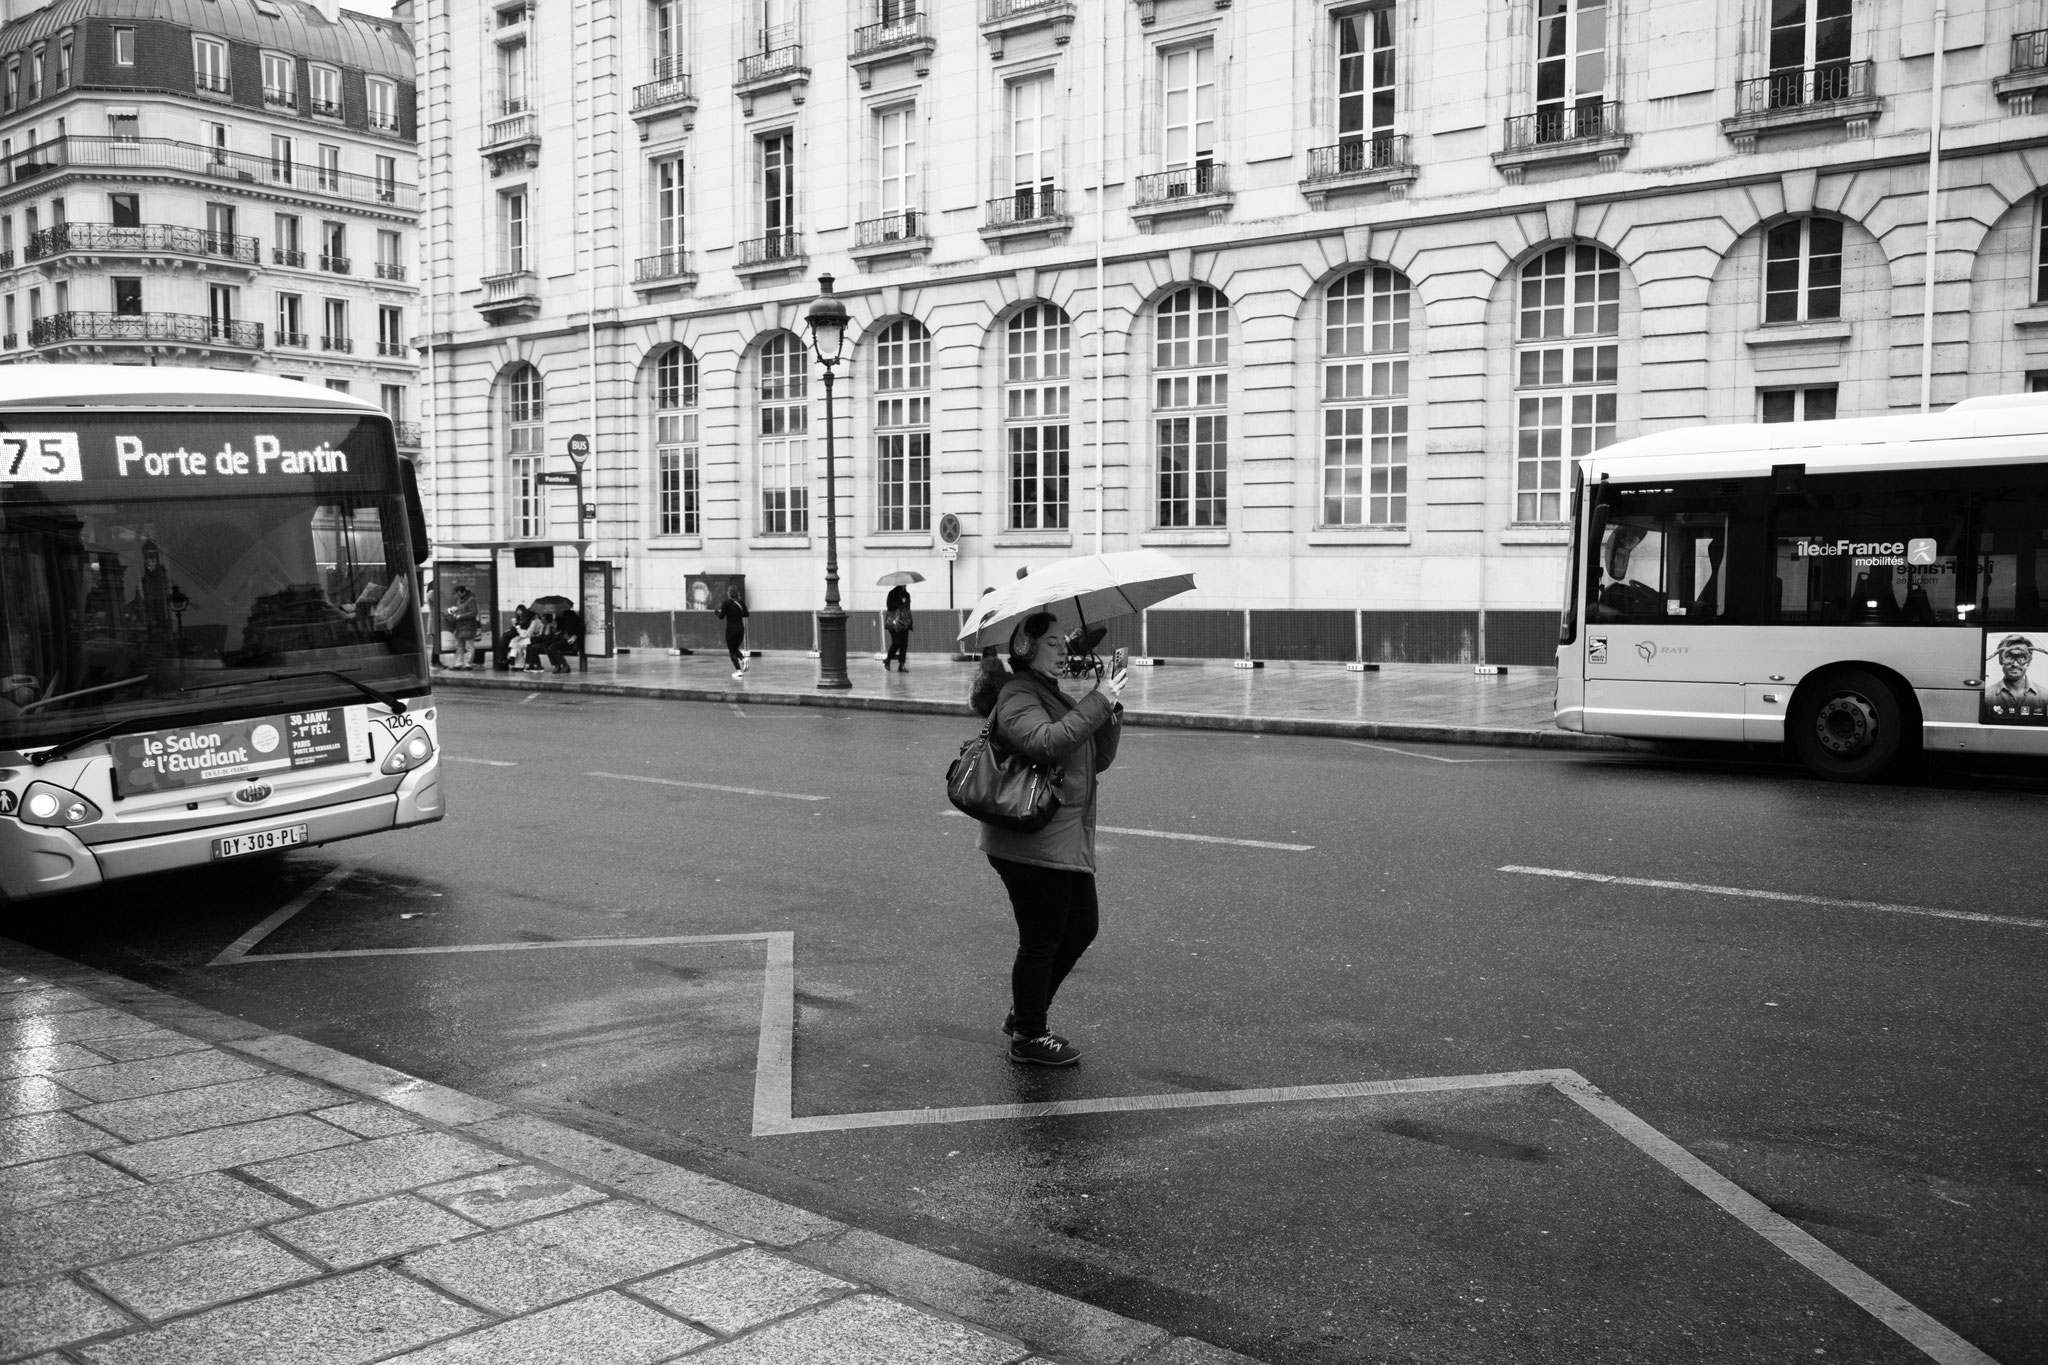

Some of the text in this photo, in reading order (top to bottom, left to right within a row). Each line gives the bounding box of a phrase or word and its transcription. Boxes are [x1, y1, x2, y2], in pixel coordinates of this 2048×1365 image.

[571, 440, 588, 450] BUS
[3, 438, 66, 475] 75
[115, 434, 348, 476] Porte de Pantin
[1855, 556, 1904, 566] mobilités
[290, 711, 331, 726] 30 JANV.
[386, 714, 413, 730] 1206
[311, 722, 331, 736] FÉV.
[143, 732, 221, 755] le Salon
[293, 739, 311, 749] PARIS
[315, 743, 341, 752] VERSAILLES
[142, 758, 156, 768] de
